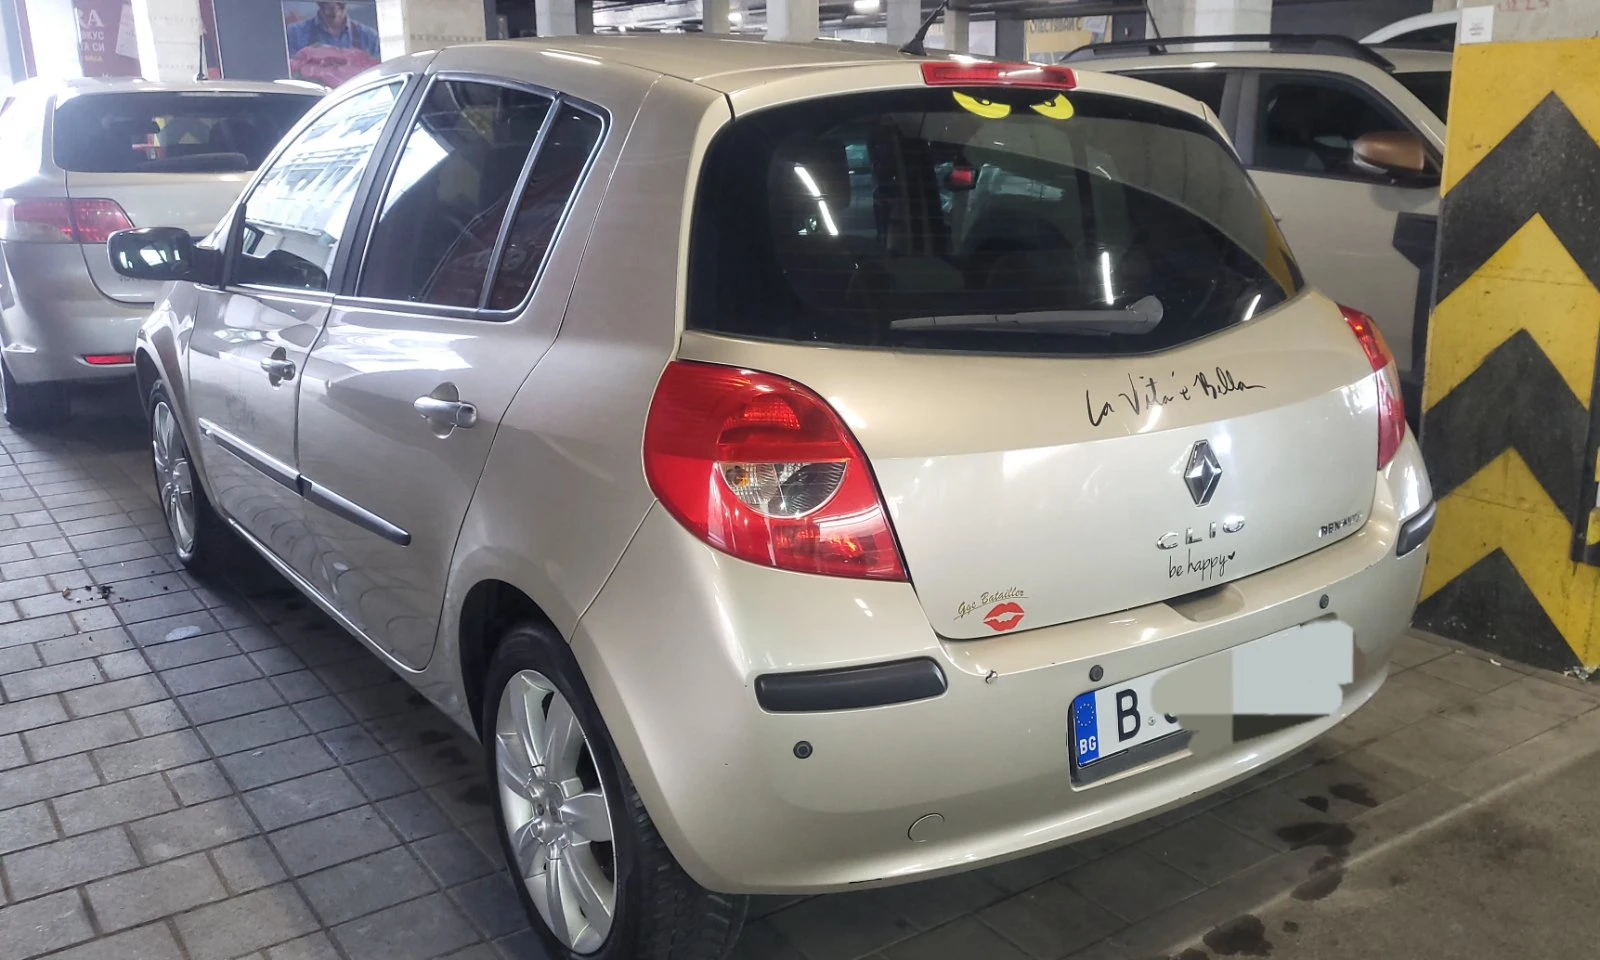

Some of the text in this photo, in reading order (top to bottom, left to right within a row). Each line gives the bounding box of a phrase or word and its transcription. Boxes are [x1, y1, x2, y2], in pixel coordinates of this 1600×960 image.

[1086, 390, 1115, 427] La
[1193, 366, 1267, 400] Bella
[1156, 515, 1246, 550] CLIO
[1168, 548, 1230, 581] be happy
[1079, 736, 1098, 755] BG
